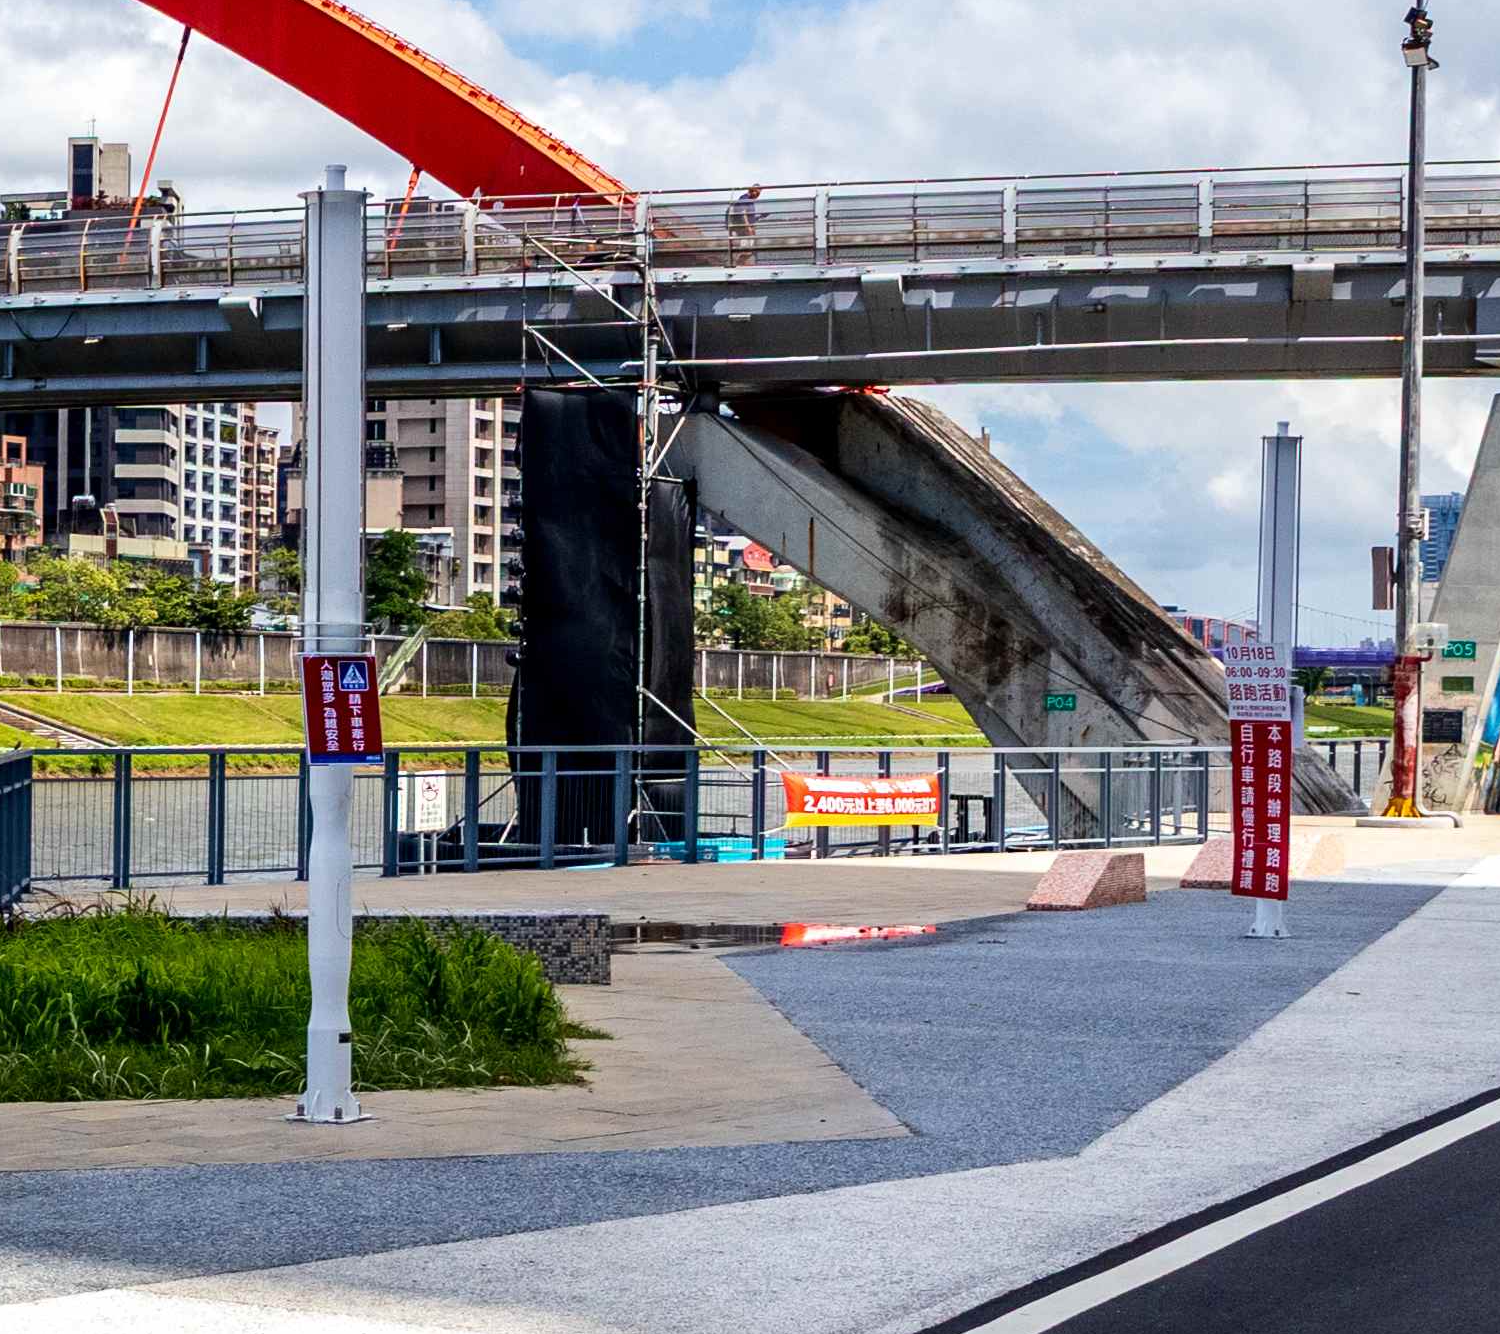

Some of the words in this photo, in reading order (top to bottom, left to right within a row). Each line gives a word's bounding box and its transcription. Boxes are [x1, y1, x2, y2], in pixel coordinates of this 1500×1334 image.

[1225, 646, 1275, 661] 10月18日
[1228, 683, 1287, 702] 路跑活動
[1239, 723, 1255, 890] 自行車請慢行禮讓
[1264, 724, 1283, 893] 本路段辦理路跑
